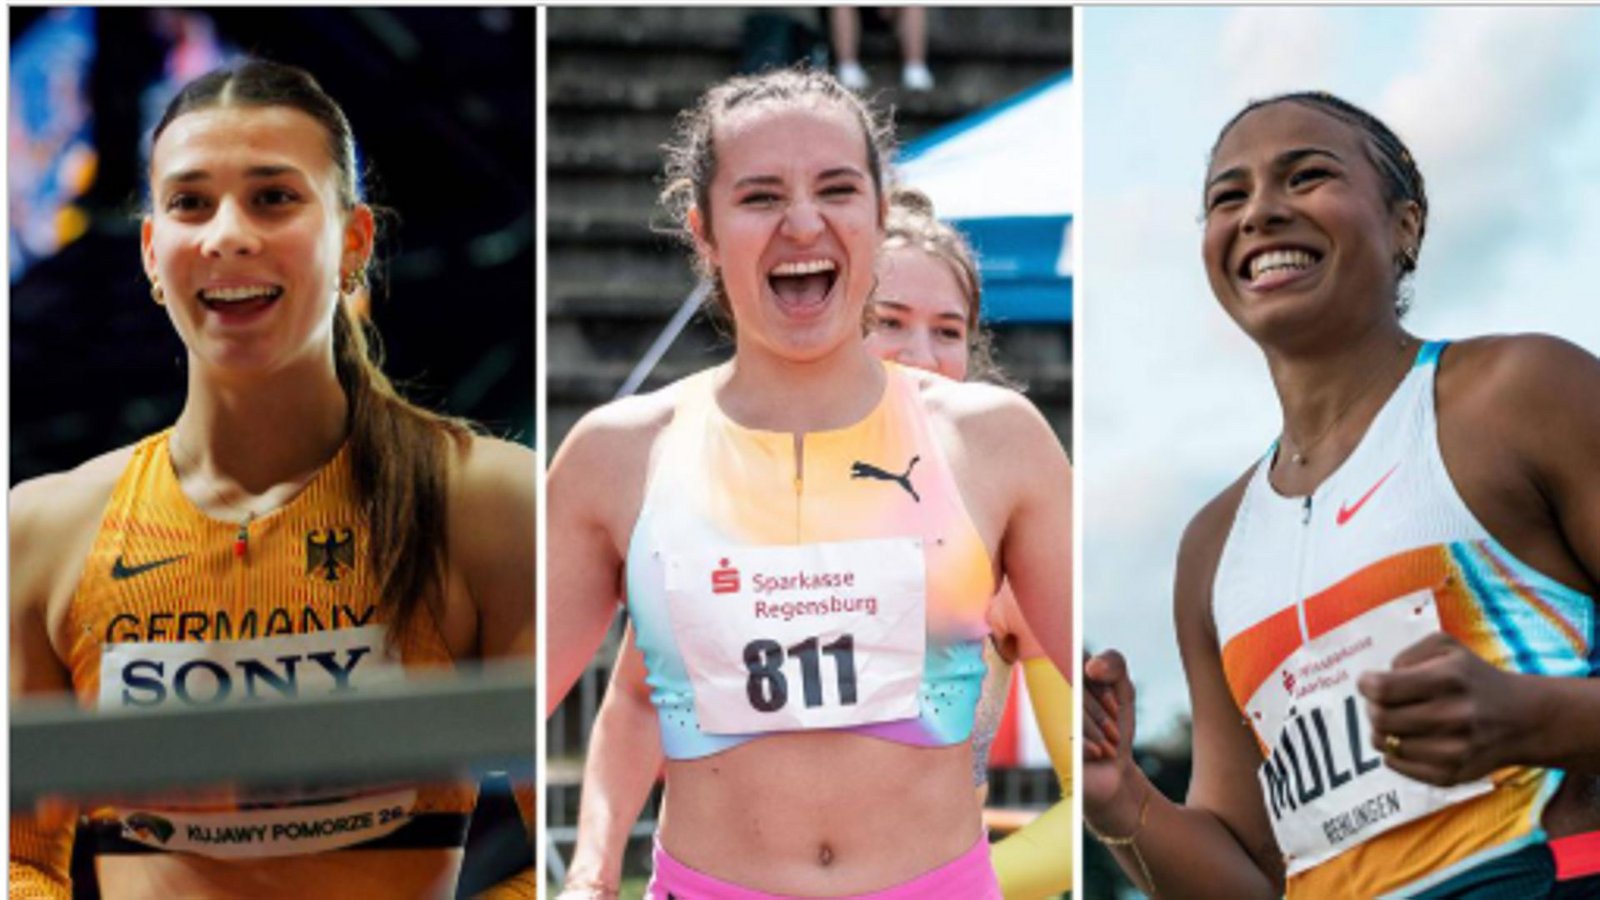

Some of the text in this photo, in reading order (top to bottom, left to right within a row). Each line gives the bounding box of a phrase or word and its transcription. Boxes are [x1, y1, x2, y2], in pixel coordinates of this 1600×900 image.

[752, 572, 855, 594] Sparkasse
[755, 596, 877, 621] Regensburg
[121, 646, 371, 706] SONY
[743, 633, 857, 713] 811
[188, 822, 266, 843] KUJAWY
[272, 811, 374, 842] POMORZE
[1322, 790, 1401, 846] REHLINGEN
